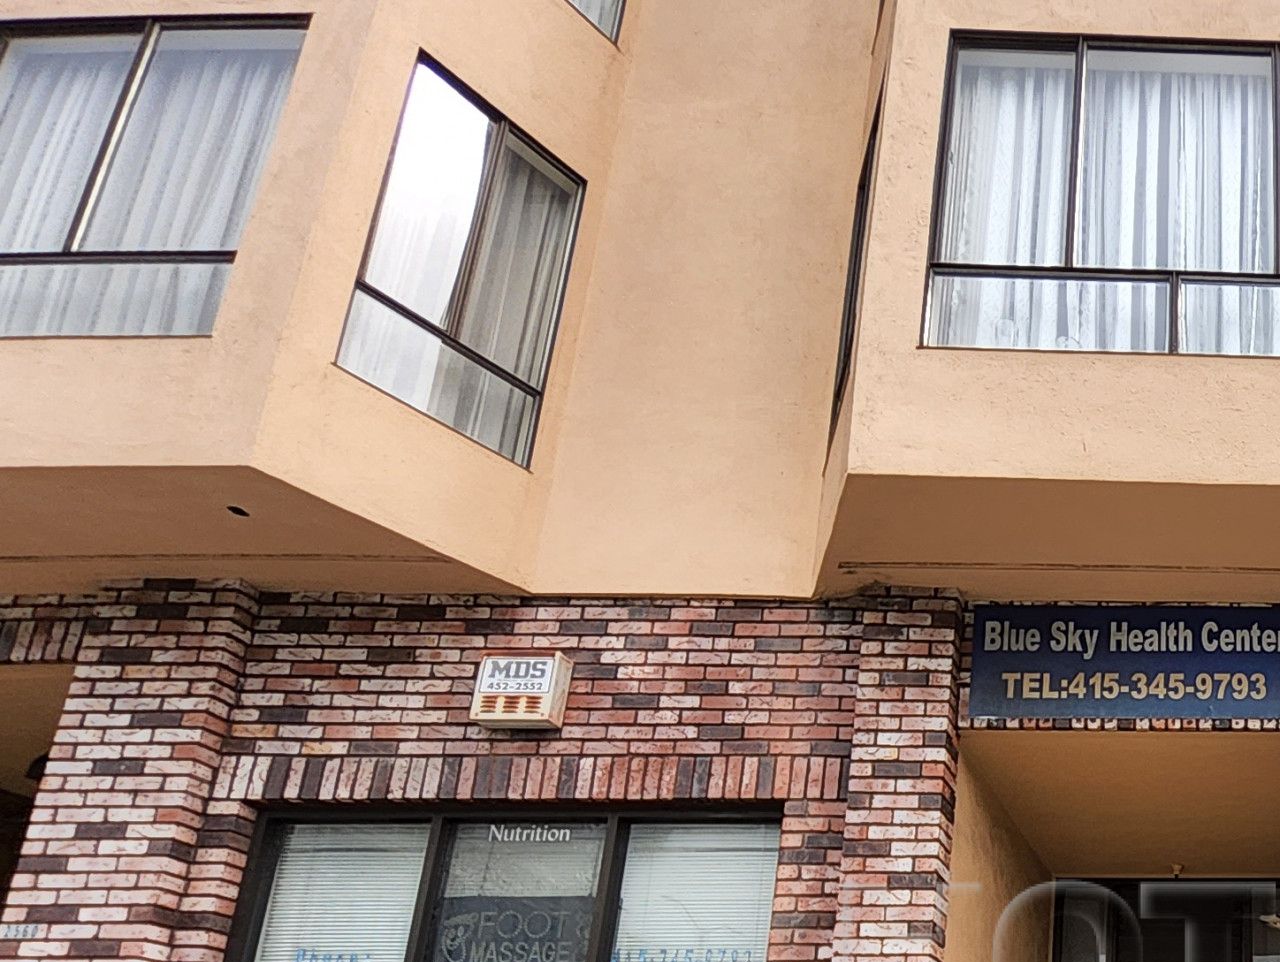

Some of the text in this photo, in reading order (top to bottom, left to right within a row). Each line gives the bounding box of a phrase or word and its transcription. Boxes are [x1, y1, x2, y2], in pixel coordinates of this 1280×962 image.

[984, 621, 1040, 651] Blue
[1050, 621, 1098, 659] Sky
[1109, 621, 1193, 652] Health
[488, 661, 549, 679] MDS
[487, 682, 543, 691] 452-2552
[1002, 672, 1267, 700] TEL:415-345-9793
[488, 824, 571, 842] Nutrition
[477, 911, 571, 938] FOOT
